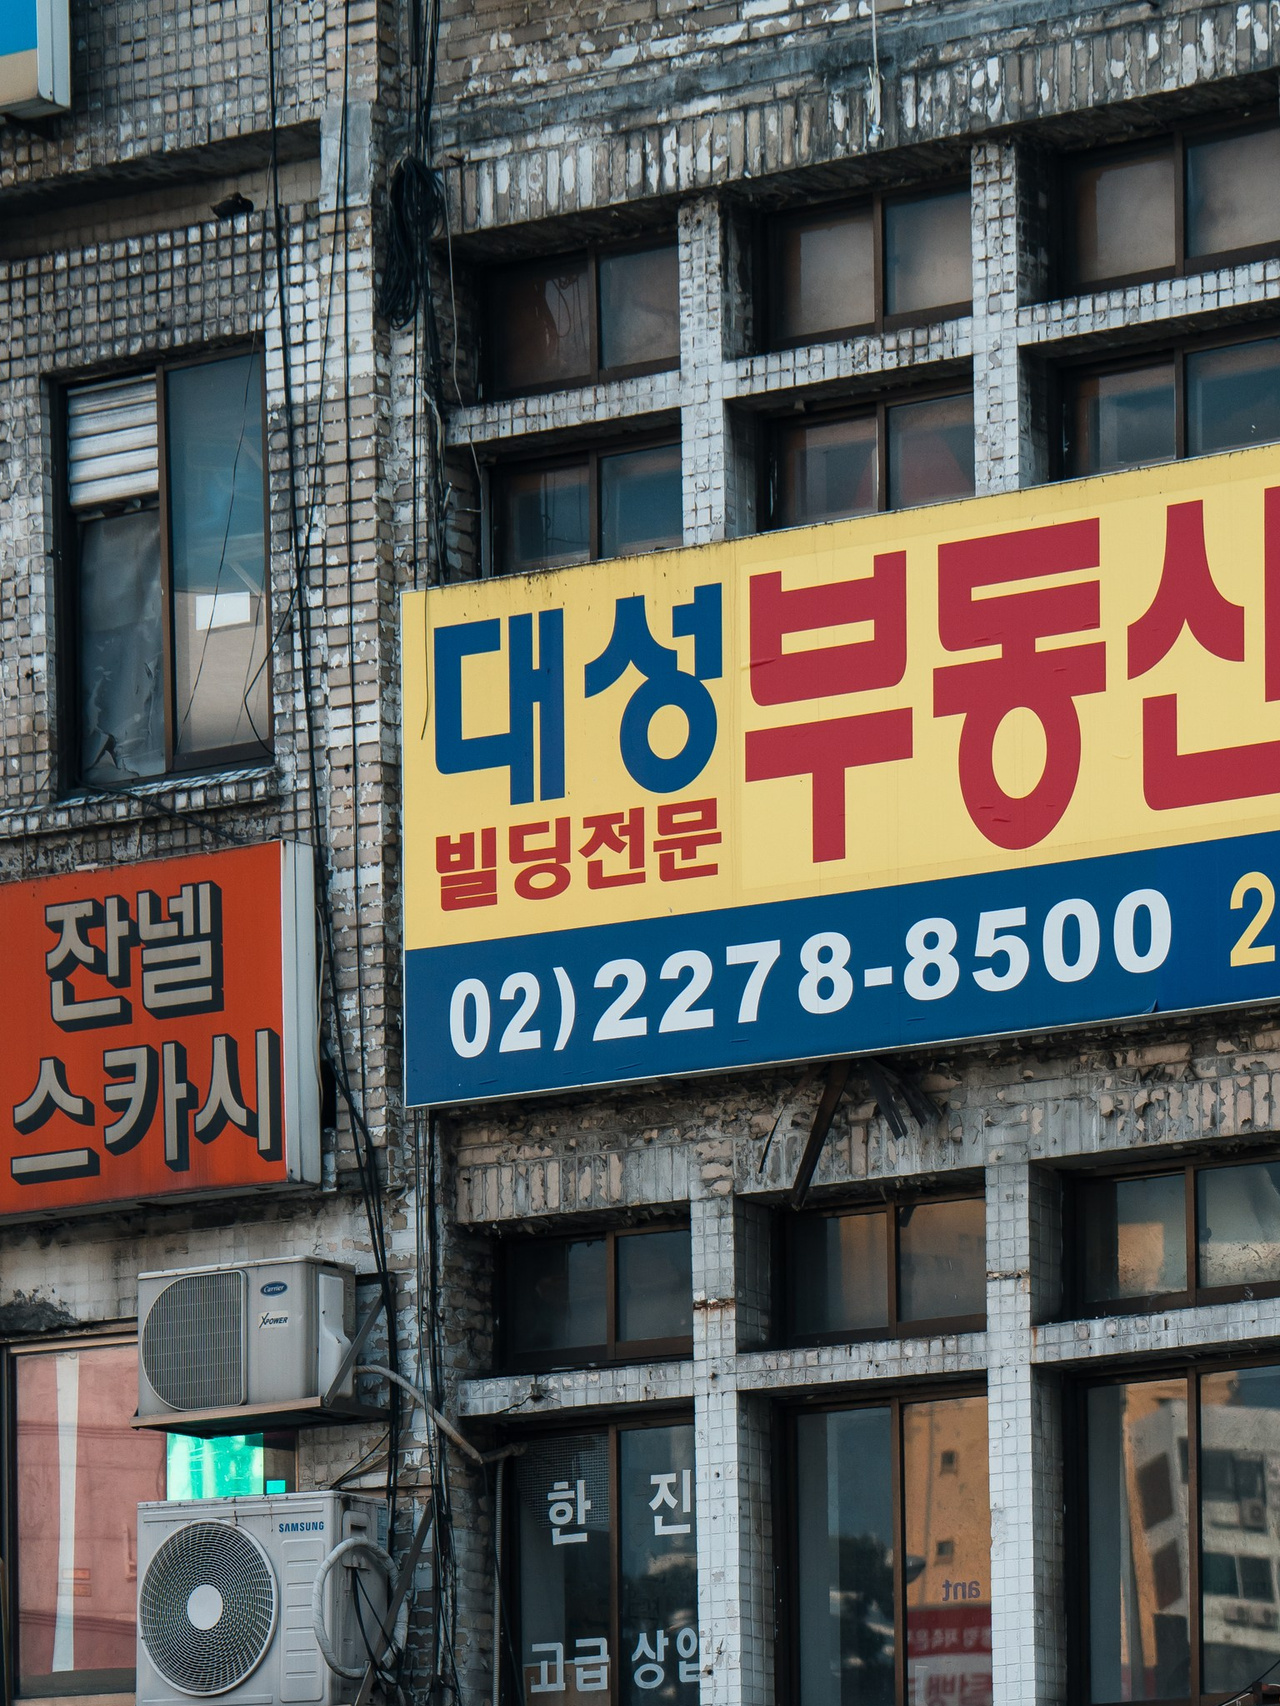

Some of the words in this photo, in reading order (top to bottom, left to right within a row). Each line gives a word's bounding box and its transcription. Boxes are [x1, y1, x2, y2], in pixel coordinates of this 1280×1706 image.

[433, 582, 723, 805] 대성
[434, 798, 723, 912] 빌딩전문
[45, 881, 224, 1033] 잔넬
[449, 888, 1173, 1060] 02)2278-8500
[11, 1028, 283, 1185] 스카시
[262, 1283, 287, 1294] Carrier
[278, 1520, 325, 1534] SAMSUNG
[531, 1637, 610, 1693] 고급
